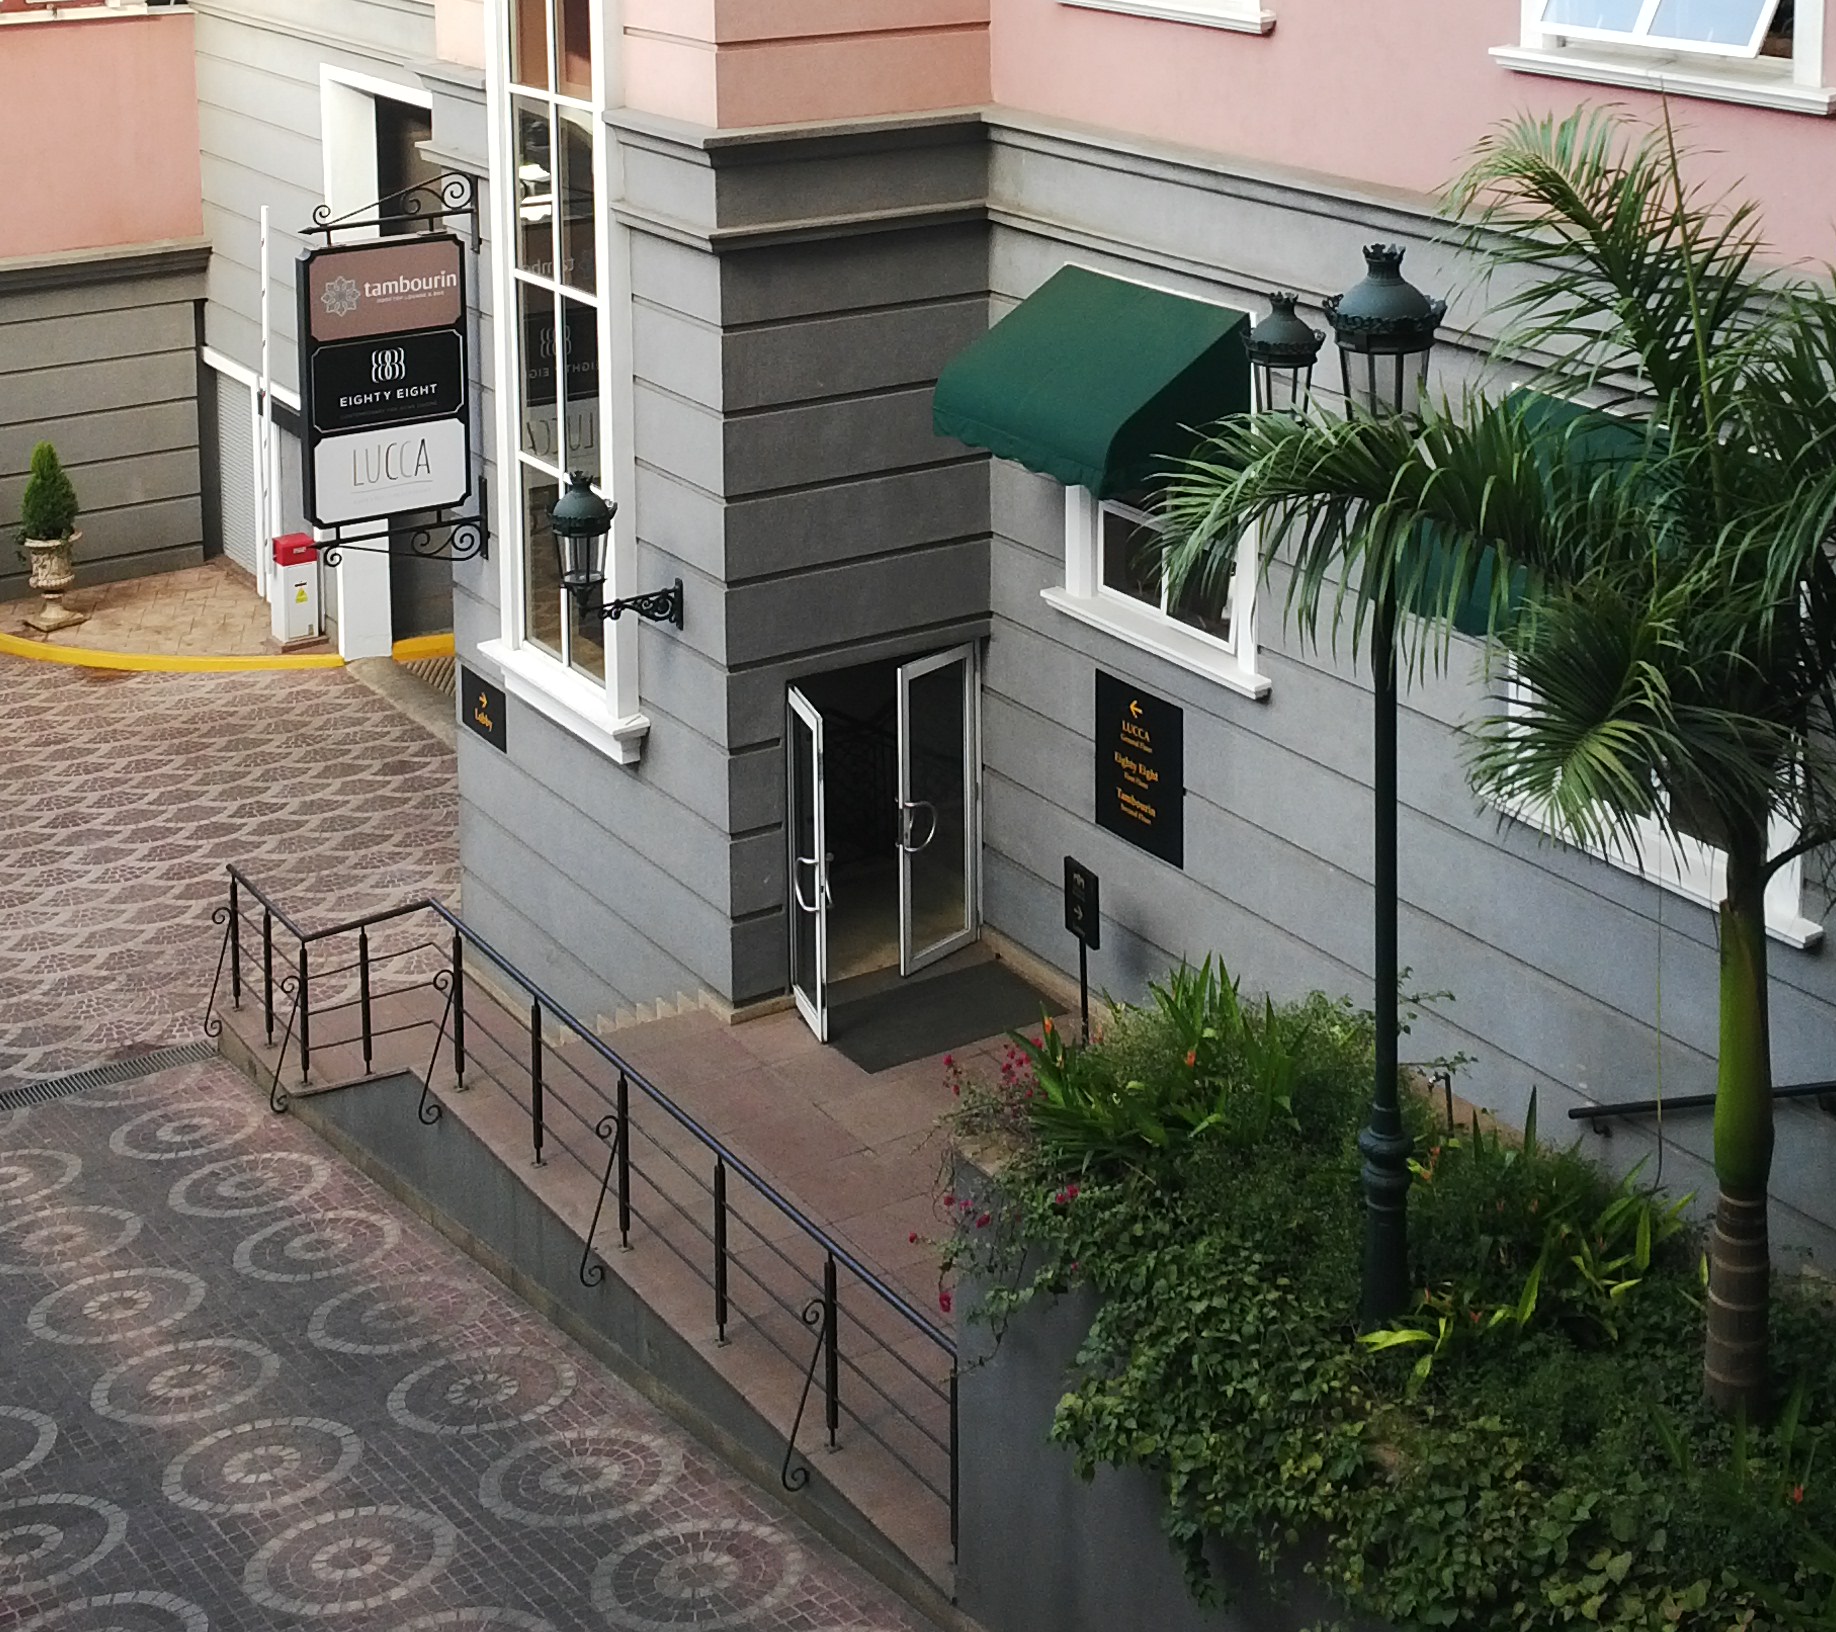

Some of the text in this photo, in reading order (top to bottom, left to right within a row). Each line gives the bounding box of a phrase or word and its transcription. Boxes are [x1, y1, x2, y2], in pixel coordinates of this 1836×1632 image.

[363, 270, 457, 298] tambourin
[340, 383, 438, 408] EIGHTY EIGHT
[353, 438, 431, 486] LUCCA
[1121, 720, 1150, 743] LUCCA
